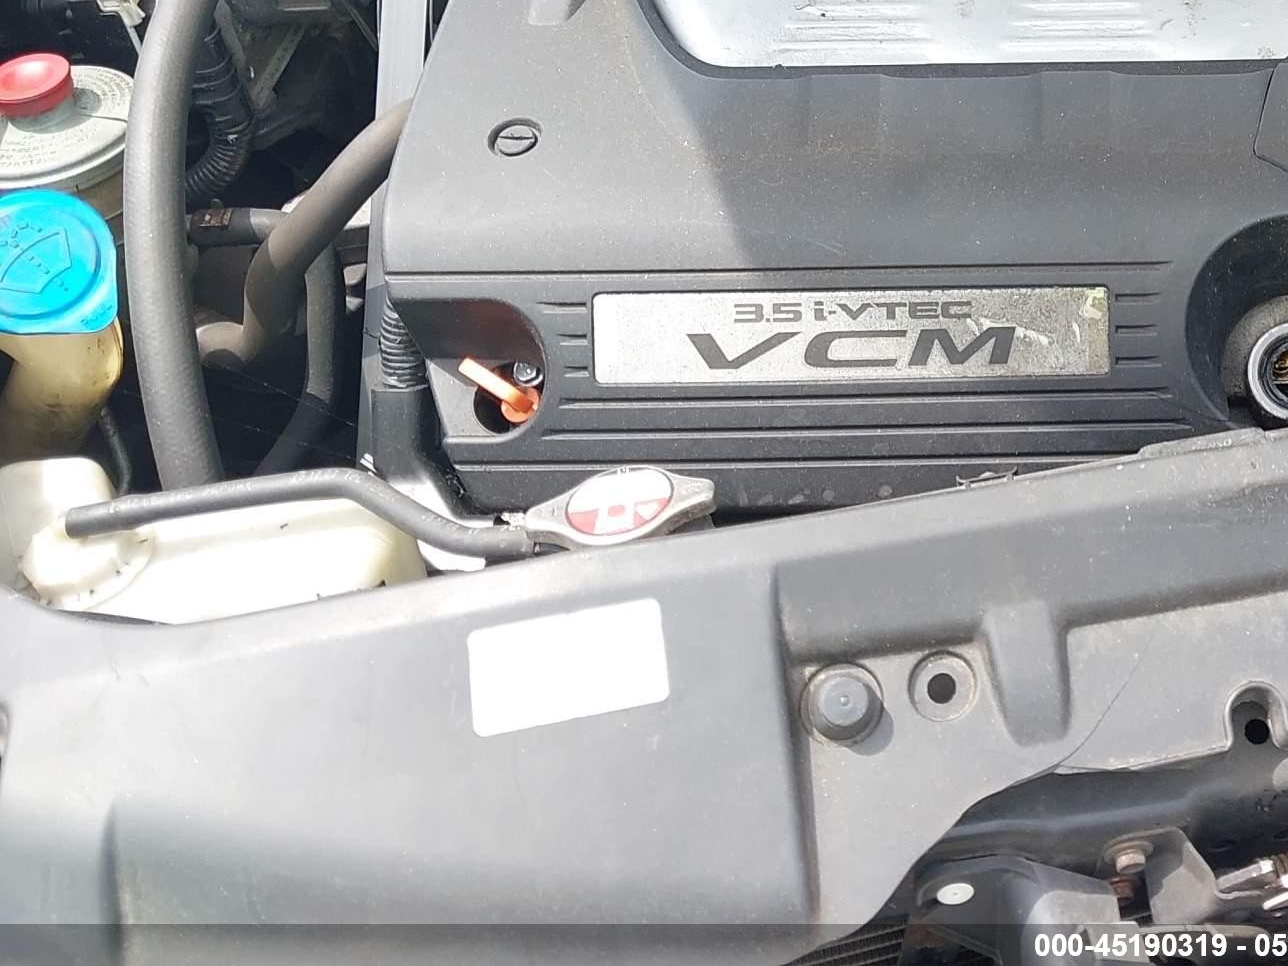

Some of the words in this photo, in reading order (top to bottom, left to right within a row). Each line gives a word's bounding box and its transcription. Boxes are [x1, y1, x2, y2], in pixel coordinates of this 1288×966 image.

[733, 302, 802, 323] 3.5
[813, 300, 973, 322] i-VTEC
[686, 326, 1017, 370] VCM
